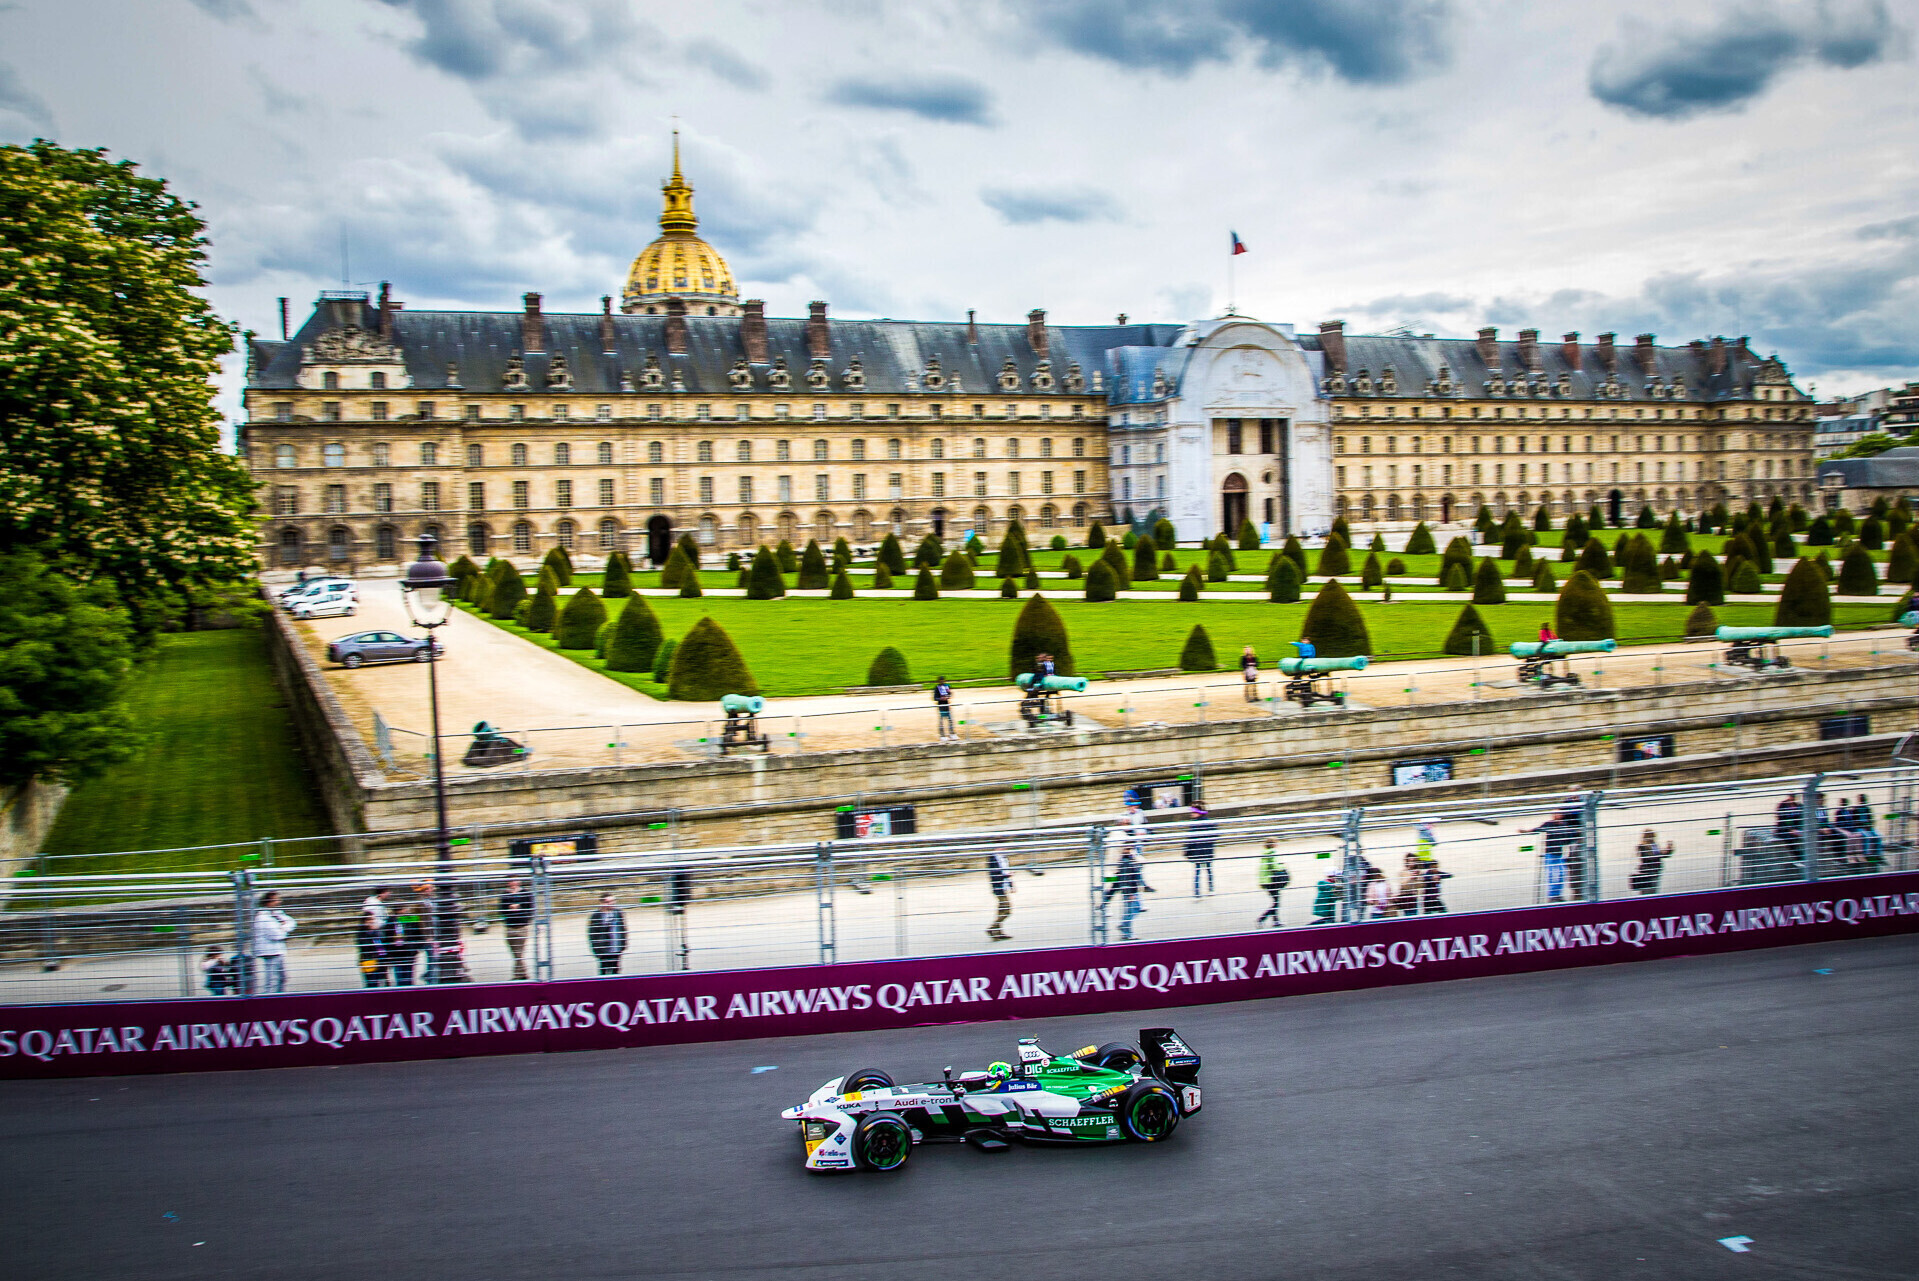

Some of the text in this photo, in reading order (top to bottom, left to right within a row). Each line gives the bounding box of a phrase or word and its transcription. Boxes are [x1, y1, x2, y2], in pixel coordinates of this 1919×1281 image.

[22, 1027, 147, 1062] QATAR
[152, 1018, 309, 1051] AIRWAYS
[309, 1011, 436, 1049] QATAR
[442, 1001, 596, 1036] AIRWAYS
[599, 995, 720, 1032] QATAR
[724, 984, 873, 1019] AIRWAYS
[876, 976, 993, 1014] QATAR
[997, 964, 1138, 1000] AIRWAYS
[1139, 956, 1250, 993] QATAR
[1254, 943, 1386, 979] AIRWAYS
[1387, 934, 1491, 969] QATAR
[1494, 921, 1618, 956] AIRWAYS
[1619, 913, 1716, 947] QATAR
[1718, 900, 1834, 934] AIRWAYS
[1025, 1064, 1042, 1075] DIG
[837, 1102, 862, 1110] KUKA
[894, 1096, 952, 1107] Audi e-tron
[1049, 1115, 1114, 1128] SCHAEFFLER
